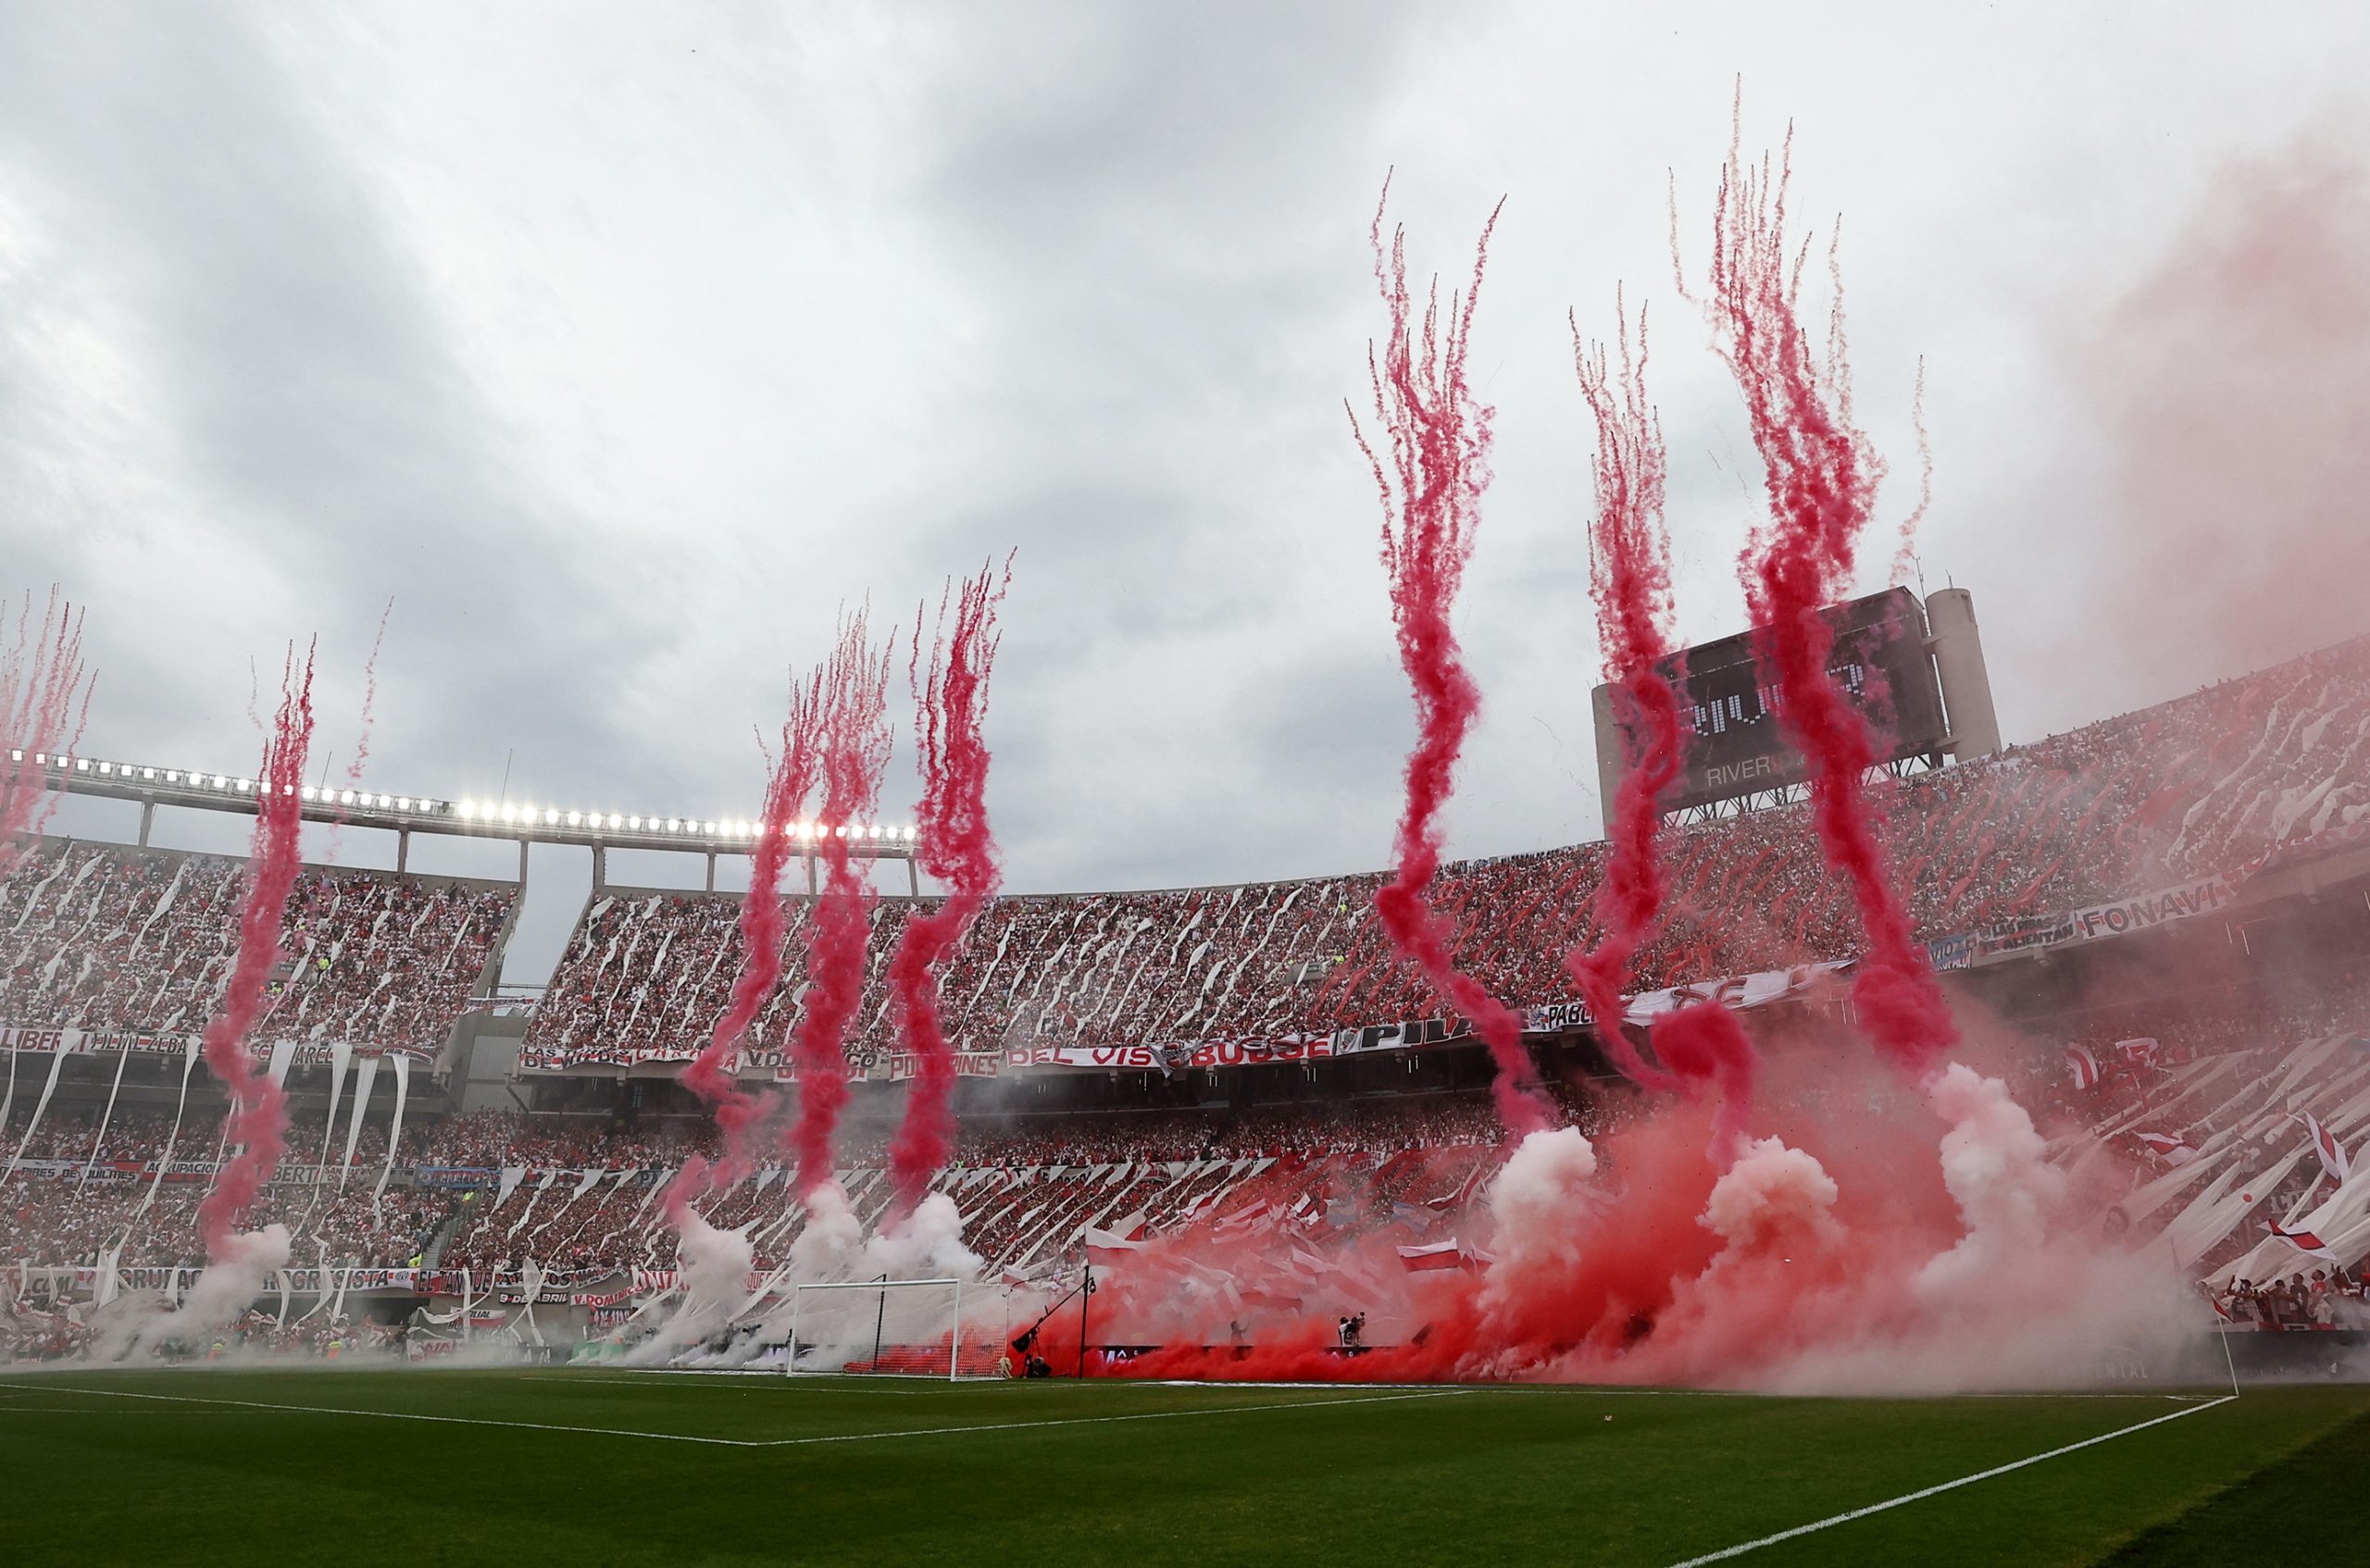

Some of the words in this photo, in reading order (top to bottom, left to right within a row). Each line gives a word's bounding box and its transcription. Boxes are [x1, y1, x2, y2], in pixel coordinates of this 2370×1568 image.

[2082, 882, 2219, 938] FONAVI
[1549, 1004, 1595, 1028] PABL
[1, 1029, 88, 1052] LIBERI
[1361, 1016, 1473, 1048] PILA
[92, 1033, 142, 1050] FILIAL
[523, 1047, 556, 1058] LAS
[524, 1054, 552, 1069] DE
[1008, 1047, 1073, 1064] DEL
[1091, 1047, 1151, 1065] VIS
[62, 1169, 77, 1178] DE
[418, 1271, 433, 1292] EL
[468, 1310, 491, 1319] ILIAL
